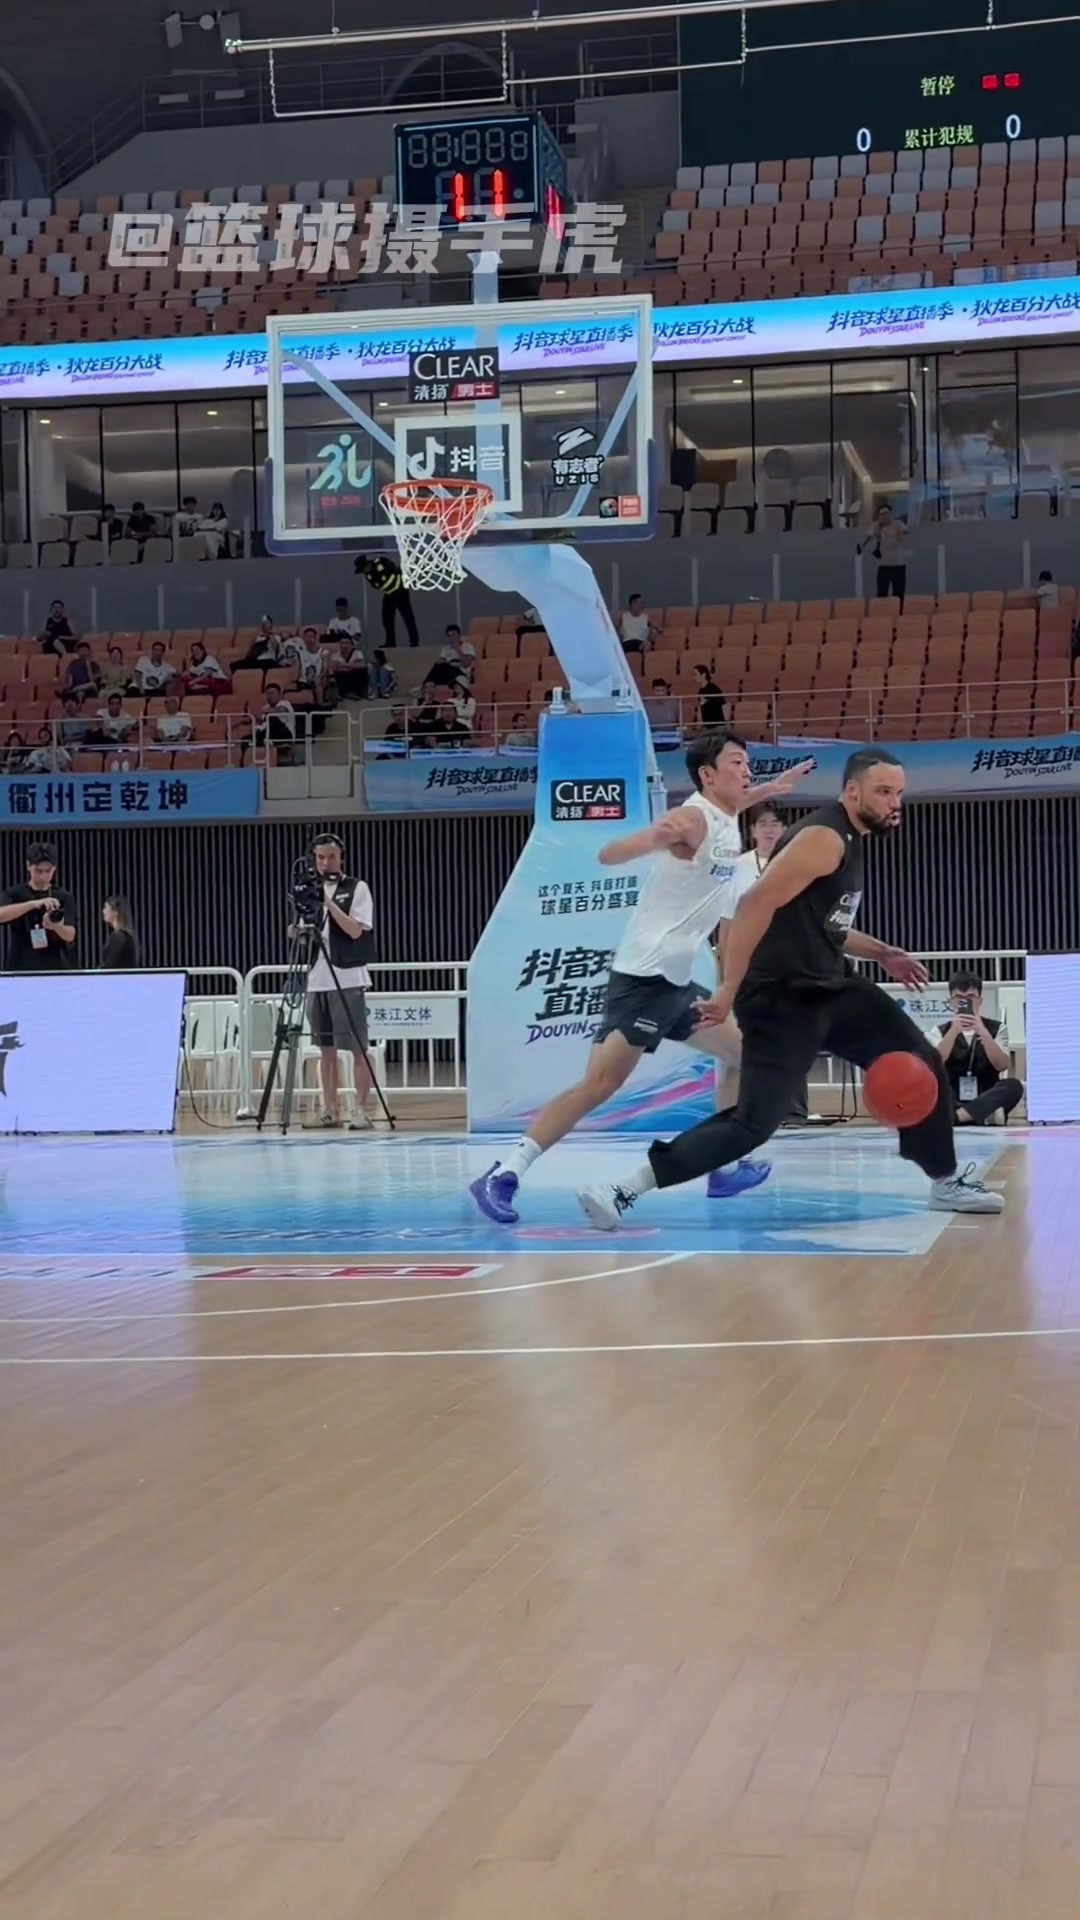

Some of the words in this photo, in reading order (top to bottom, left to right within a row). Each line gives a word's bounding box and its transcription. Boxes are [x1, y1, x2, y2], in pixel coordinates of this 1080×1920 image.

[920, 75, 955, 96] 暂停
[856, 128, 871, 152] 0
[904, 125, 974, 149] 累计犯规
[1006, 114, 1021, 139] 0
[511, 323, 634, 353] 抖音球星直播季
[413, 352, 496, 381] CLEAR
[414, 383, 450, 401] 清扬
[456, 382, 495, 398] 男士
[450, 445, 505, 473] 抖音
[555, 474, 599, 485] UZIS
[8, 779, 188, 814] 衢州定乾坤
[555, 781, 621, 804] CLEAR
[540, 890, 640, 916] 球星百分盛宴
[374, 1006, 432, 1021] 珠江文体
